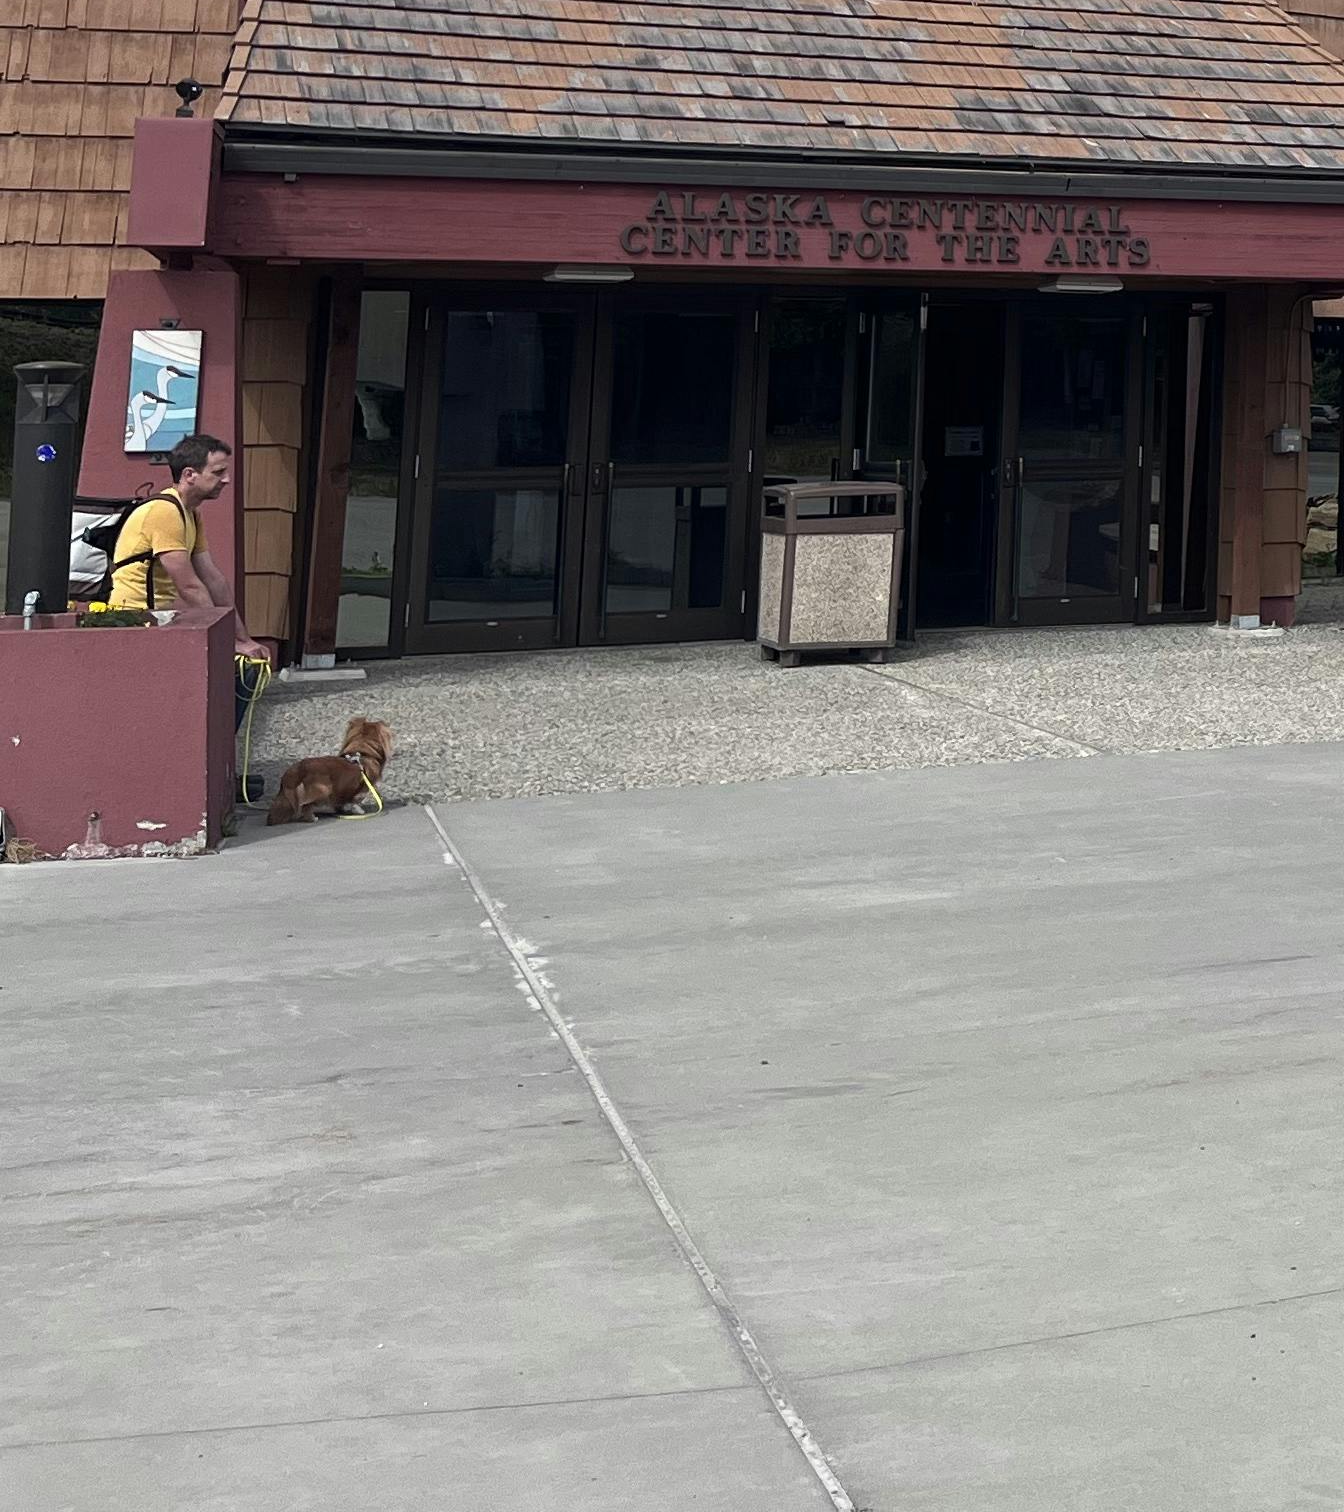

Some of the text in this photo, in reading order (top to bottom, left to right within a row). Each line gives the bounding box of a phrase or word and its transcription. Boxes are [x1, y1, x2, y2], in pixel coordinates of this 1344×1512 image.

[647, 190, 1130, 235] ALASKA CENTENNIAL
[620, 223, 1151, 267] CENTER FOR THE ARTS
